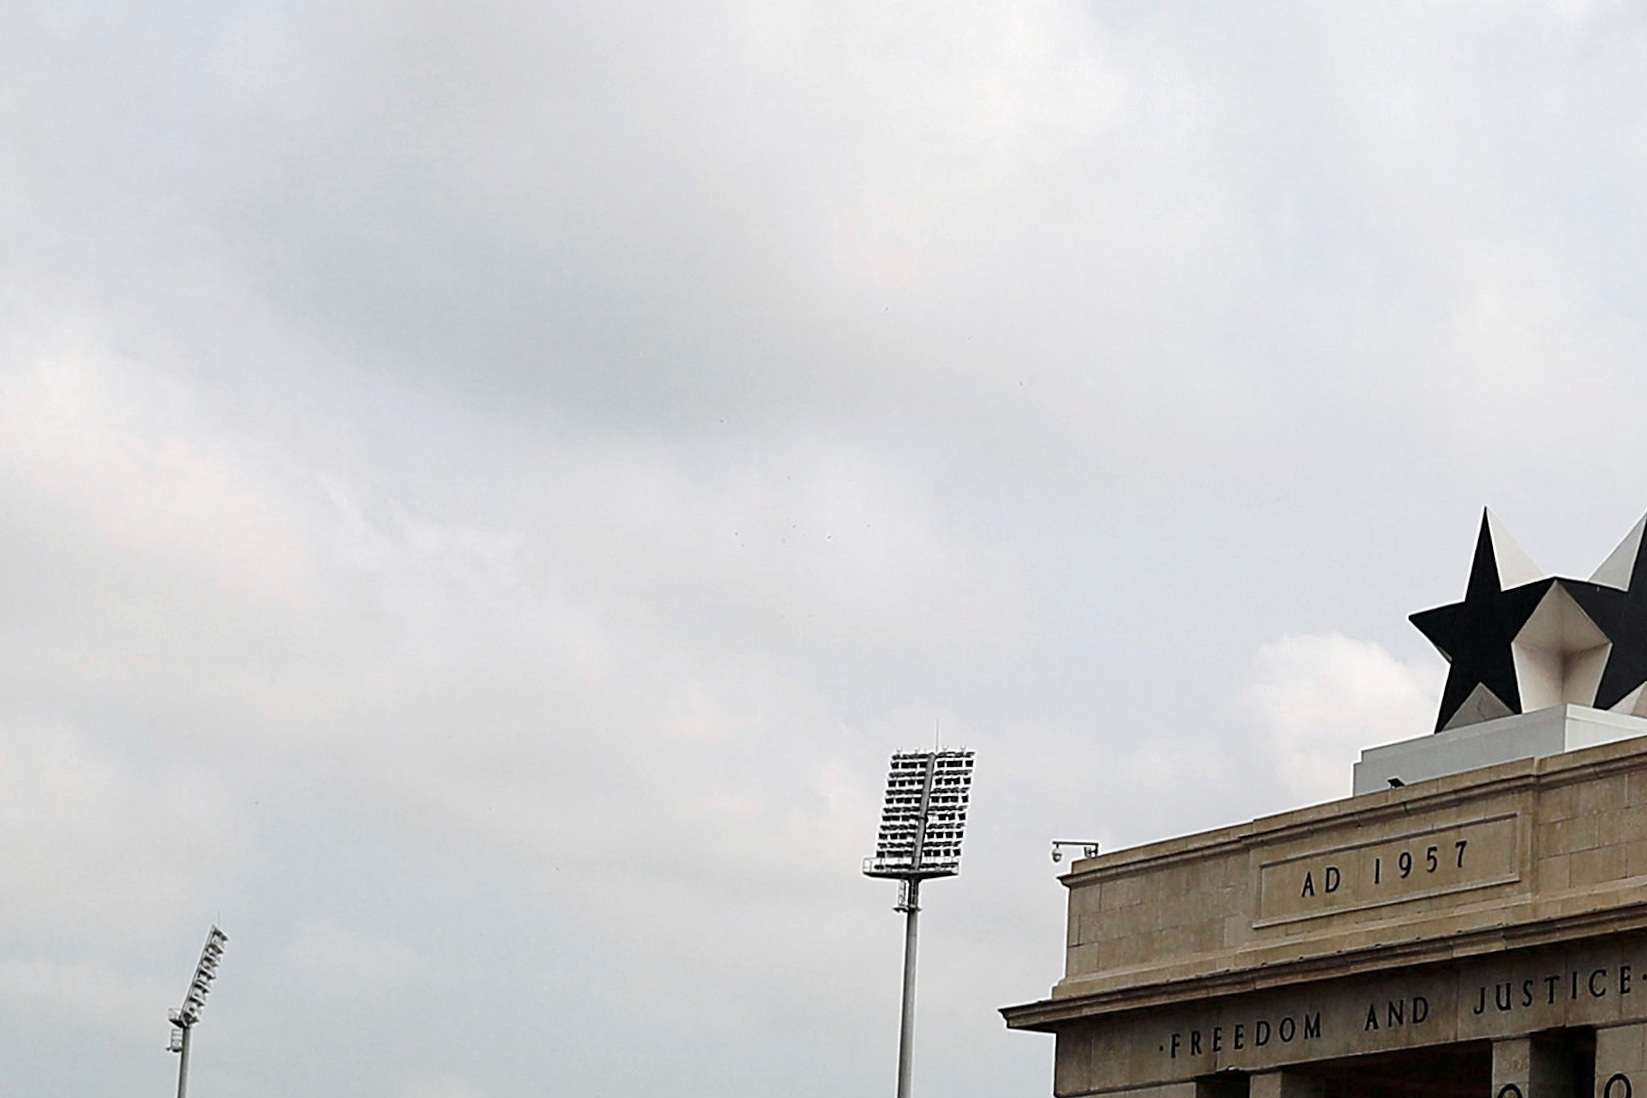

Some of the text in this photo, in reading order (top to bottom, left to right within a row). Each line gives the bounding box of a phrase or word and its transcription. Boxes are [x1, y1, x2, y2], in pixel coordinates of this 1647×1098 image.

[1301, 840, 1468, 898] AD 1957
[1365, 996, 1429, 1032] AND
